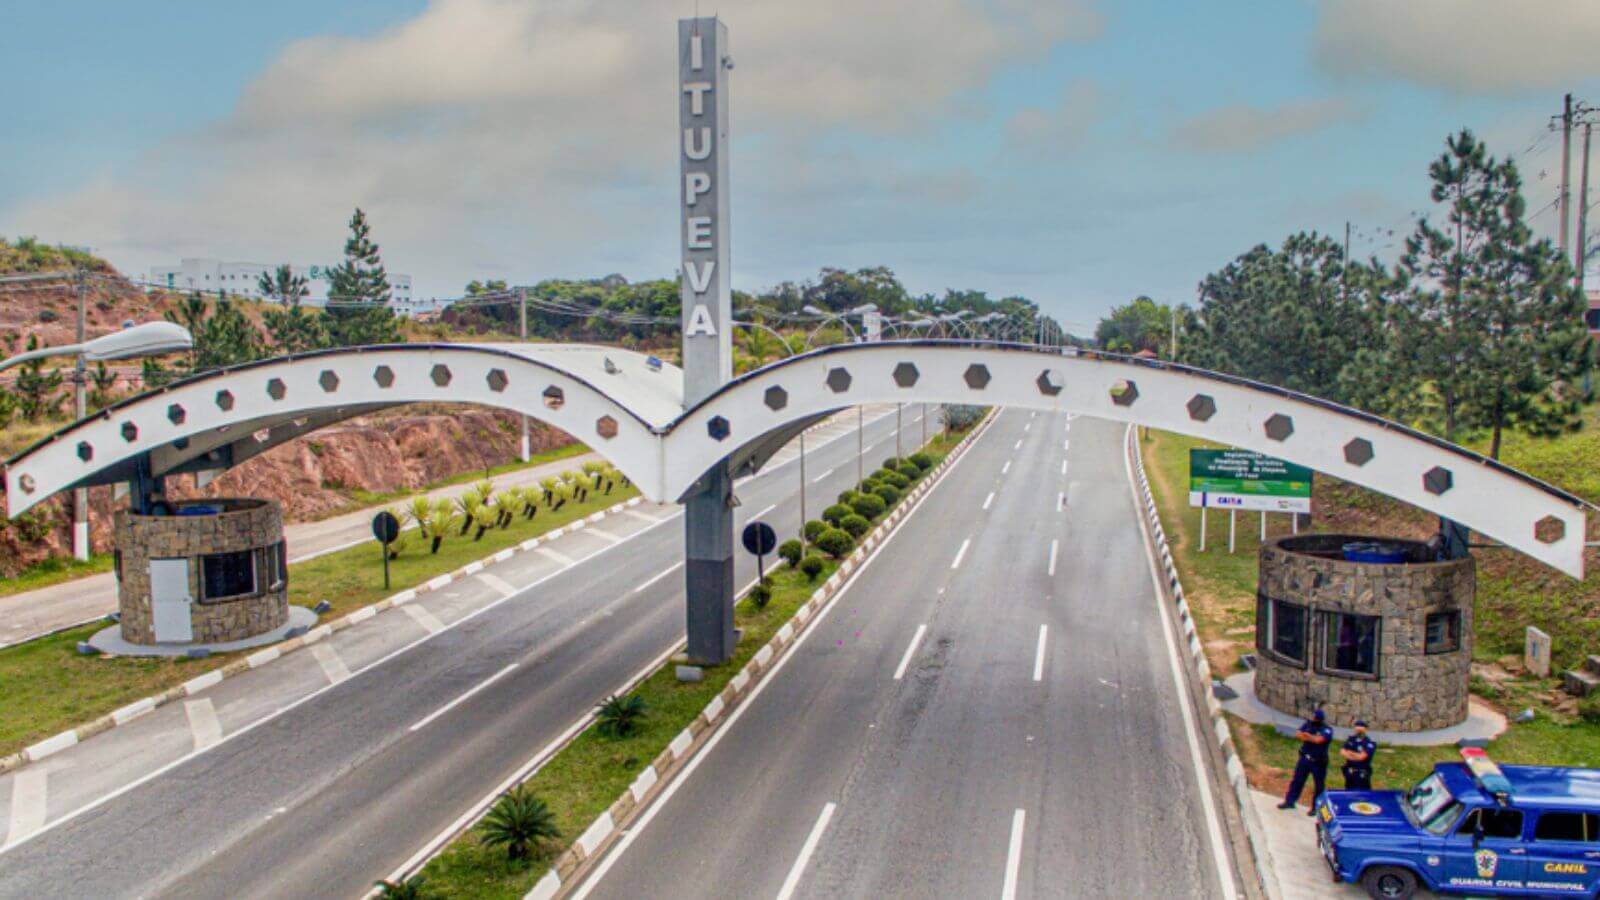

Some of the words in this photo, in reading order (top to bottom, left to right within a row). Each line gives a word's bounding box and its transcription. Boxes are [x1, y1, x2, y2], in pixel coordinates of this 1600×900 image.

[682, 35, 717, 337] ITUPEVA
[1217, 496, 1242, 505] CAIXA
[1543, 862, 1588, 874] CANIL
[1449, 877, 1493, 888] GUARDA
[1496, 880, 1523, 889] CIVIL
[1526, 881, 1585, 890] MUNICIPAL
